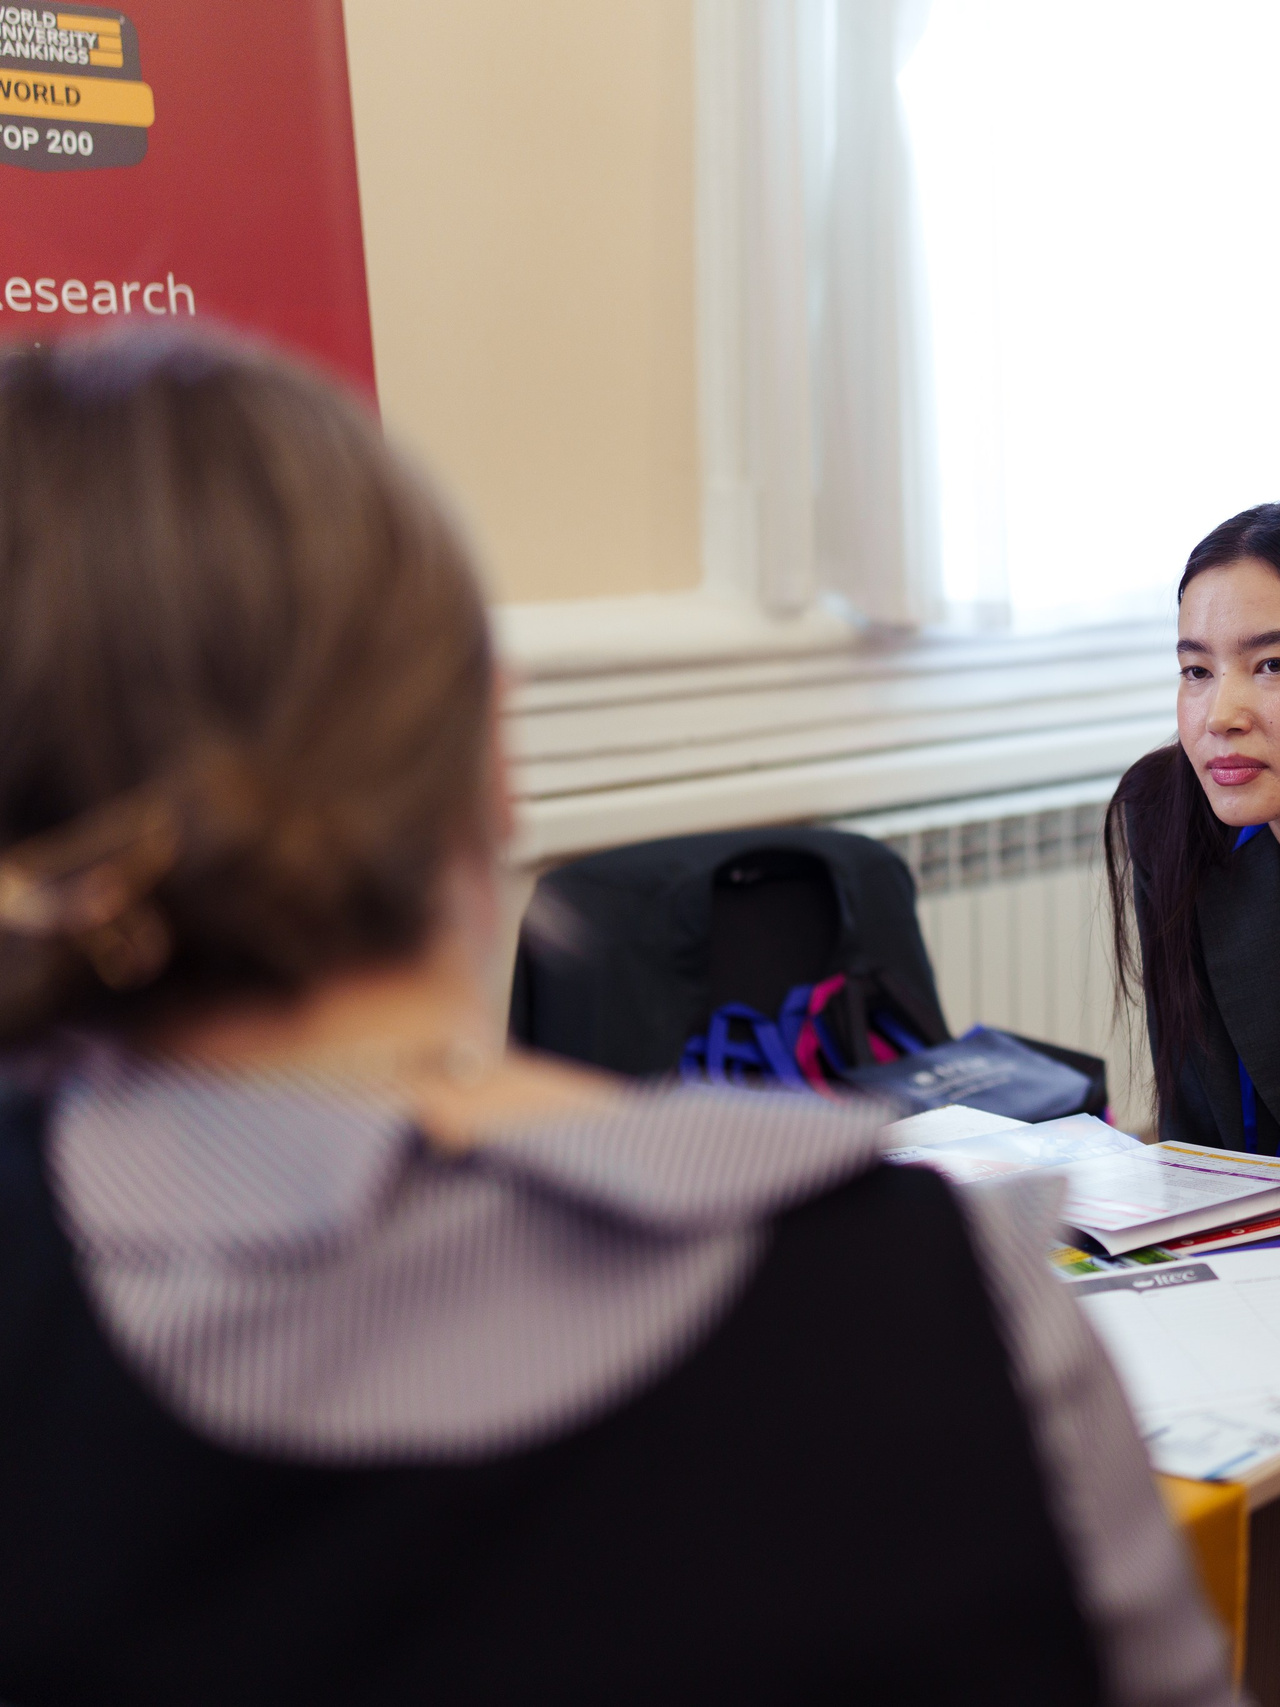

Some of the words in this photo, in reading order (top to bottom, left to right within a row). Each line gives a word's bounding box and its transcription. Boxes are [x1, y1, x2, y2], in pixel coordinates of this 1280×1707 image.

[0, 6, 56, 28] ORLD
[0, 21, 98, 50] NIVERSITY
[0, 39, 89, 65] ANKINGS
[0, 123, 39, 151] OP
[46, 128, 93, 156] 200
[0, 271, 196, 316] esearch
